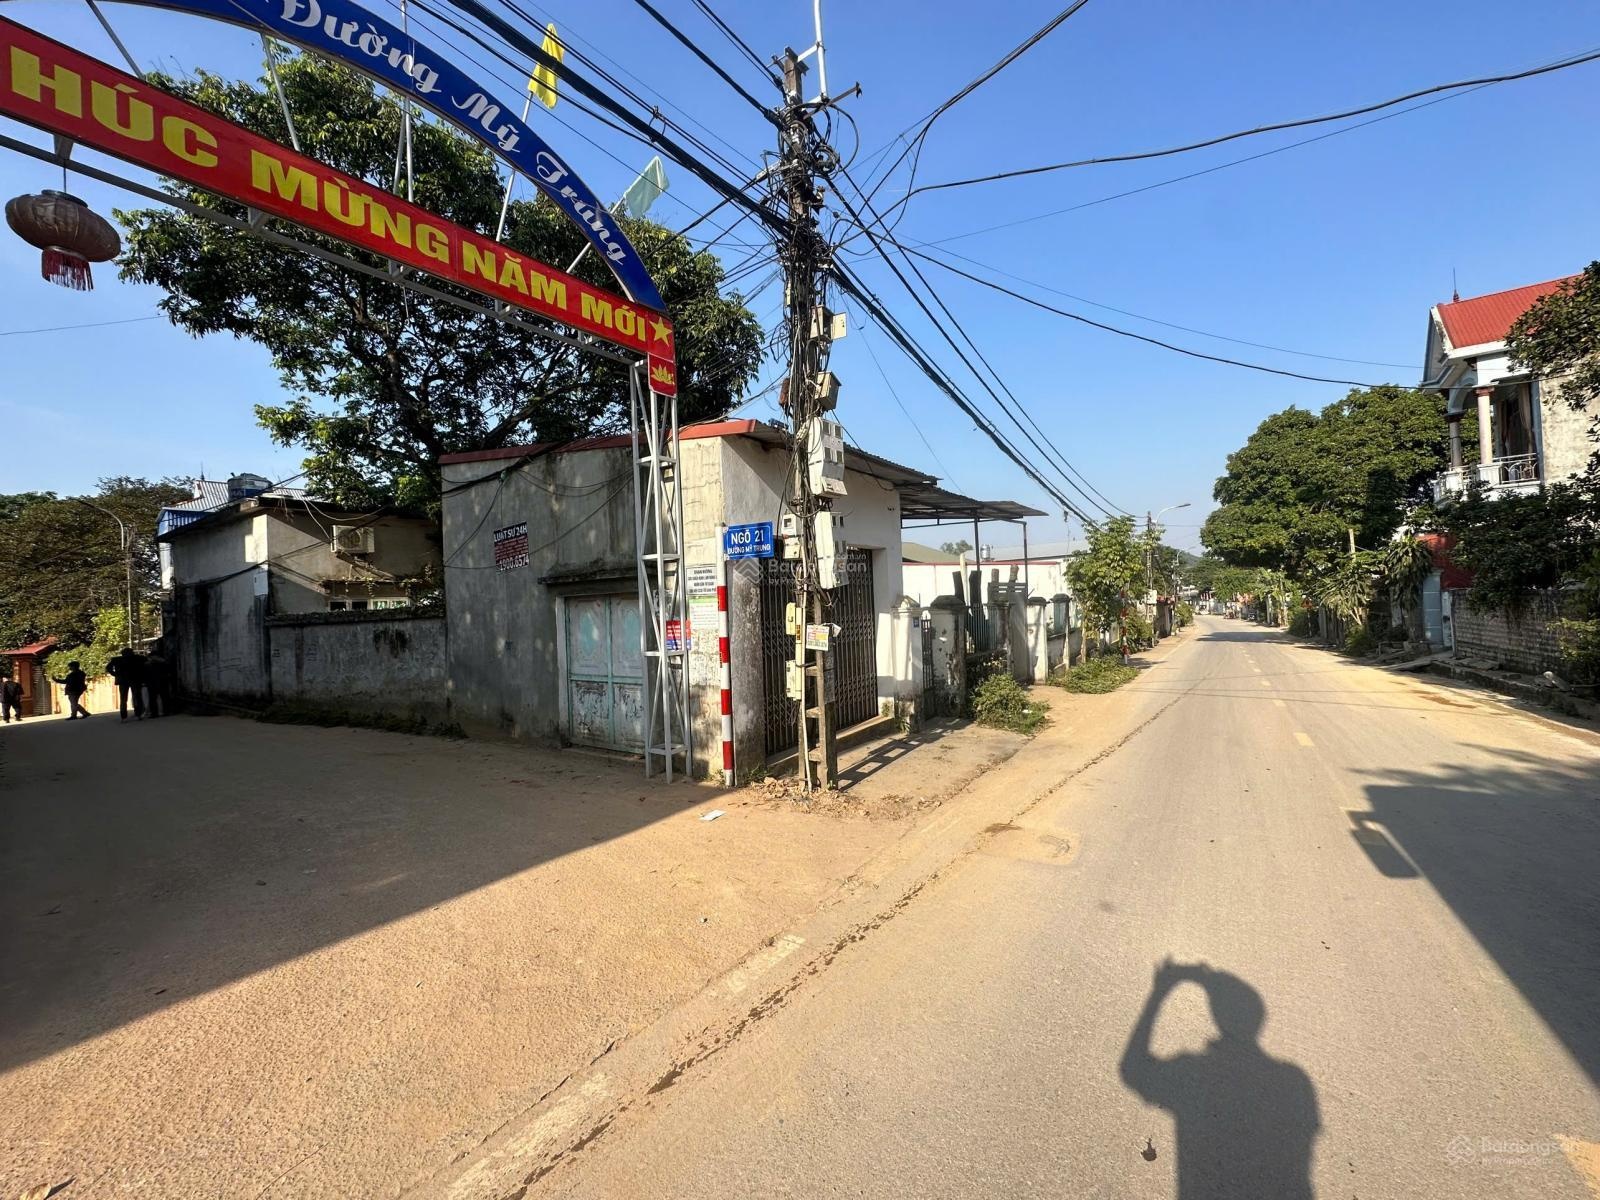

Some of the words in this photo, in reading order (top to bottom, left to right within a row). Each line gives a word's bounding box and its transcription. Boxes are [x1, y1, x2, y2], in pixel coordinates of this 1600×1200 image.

[10, 45, 218, 168] HÚC
[251, 149, 450, 264] MỪNG
[462, 240, 567, 311] NĂM
[580, 291, 647, 342] MỚI
[280, 0, 442, 94] Đường
[451, 93, 520, 153] Mỹ
[536, 151, 626, 266] Trung
[731, 529, 751, 545] NGÕ
[754, 530, 764, 543] 21
[753, 544, 771, 552] TRUNG
